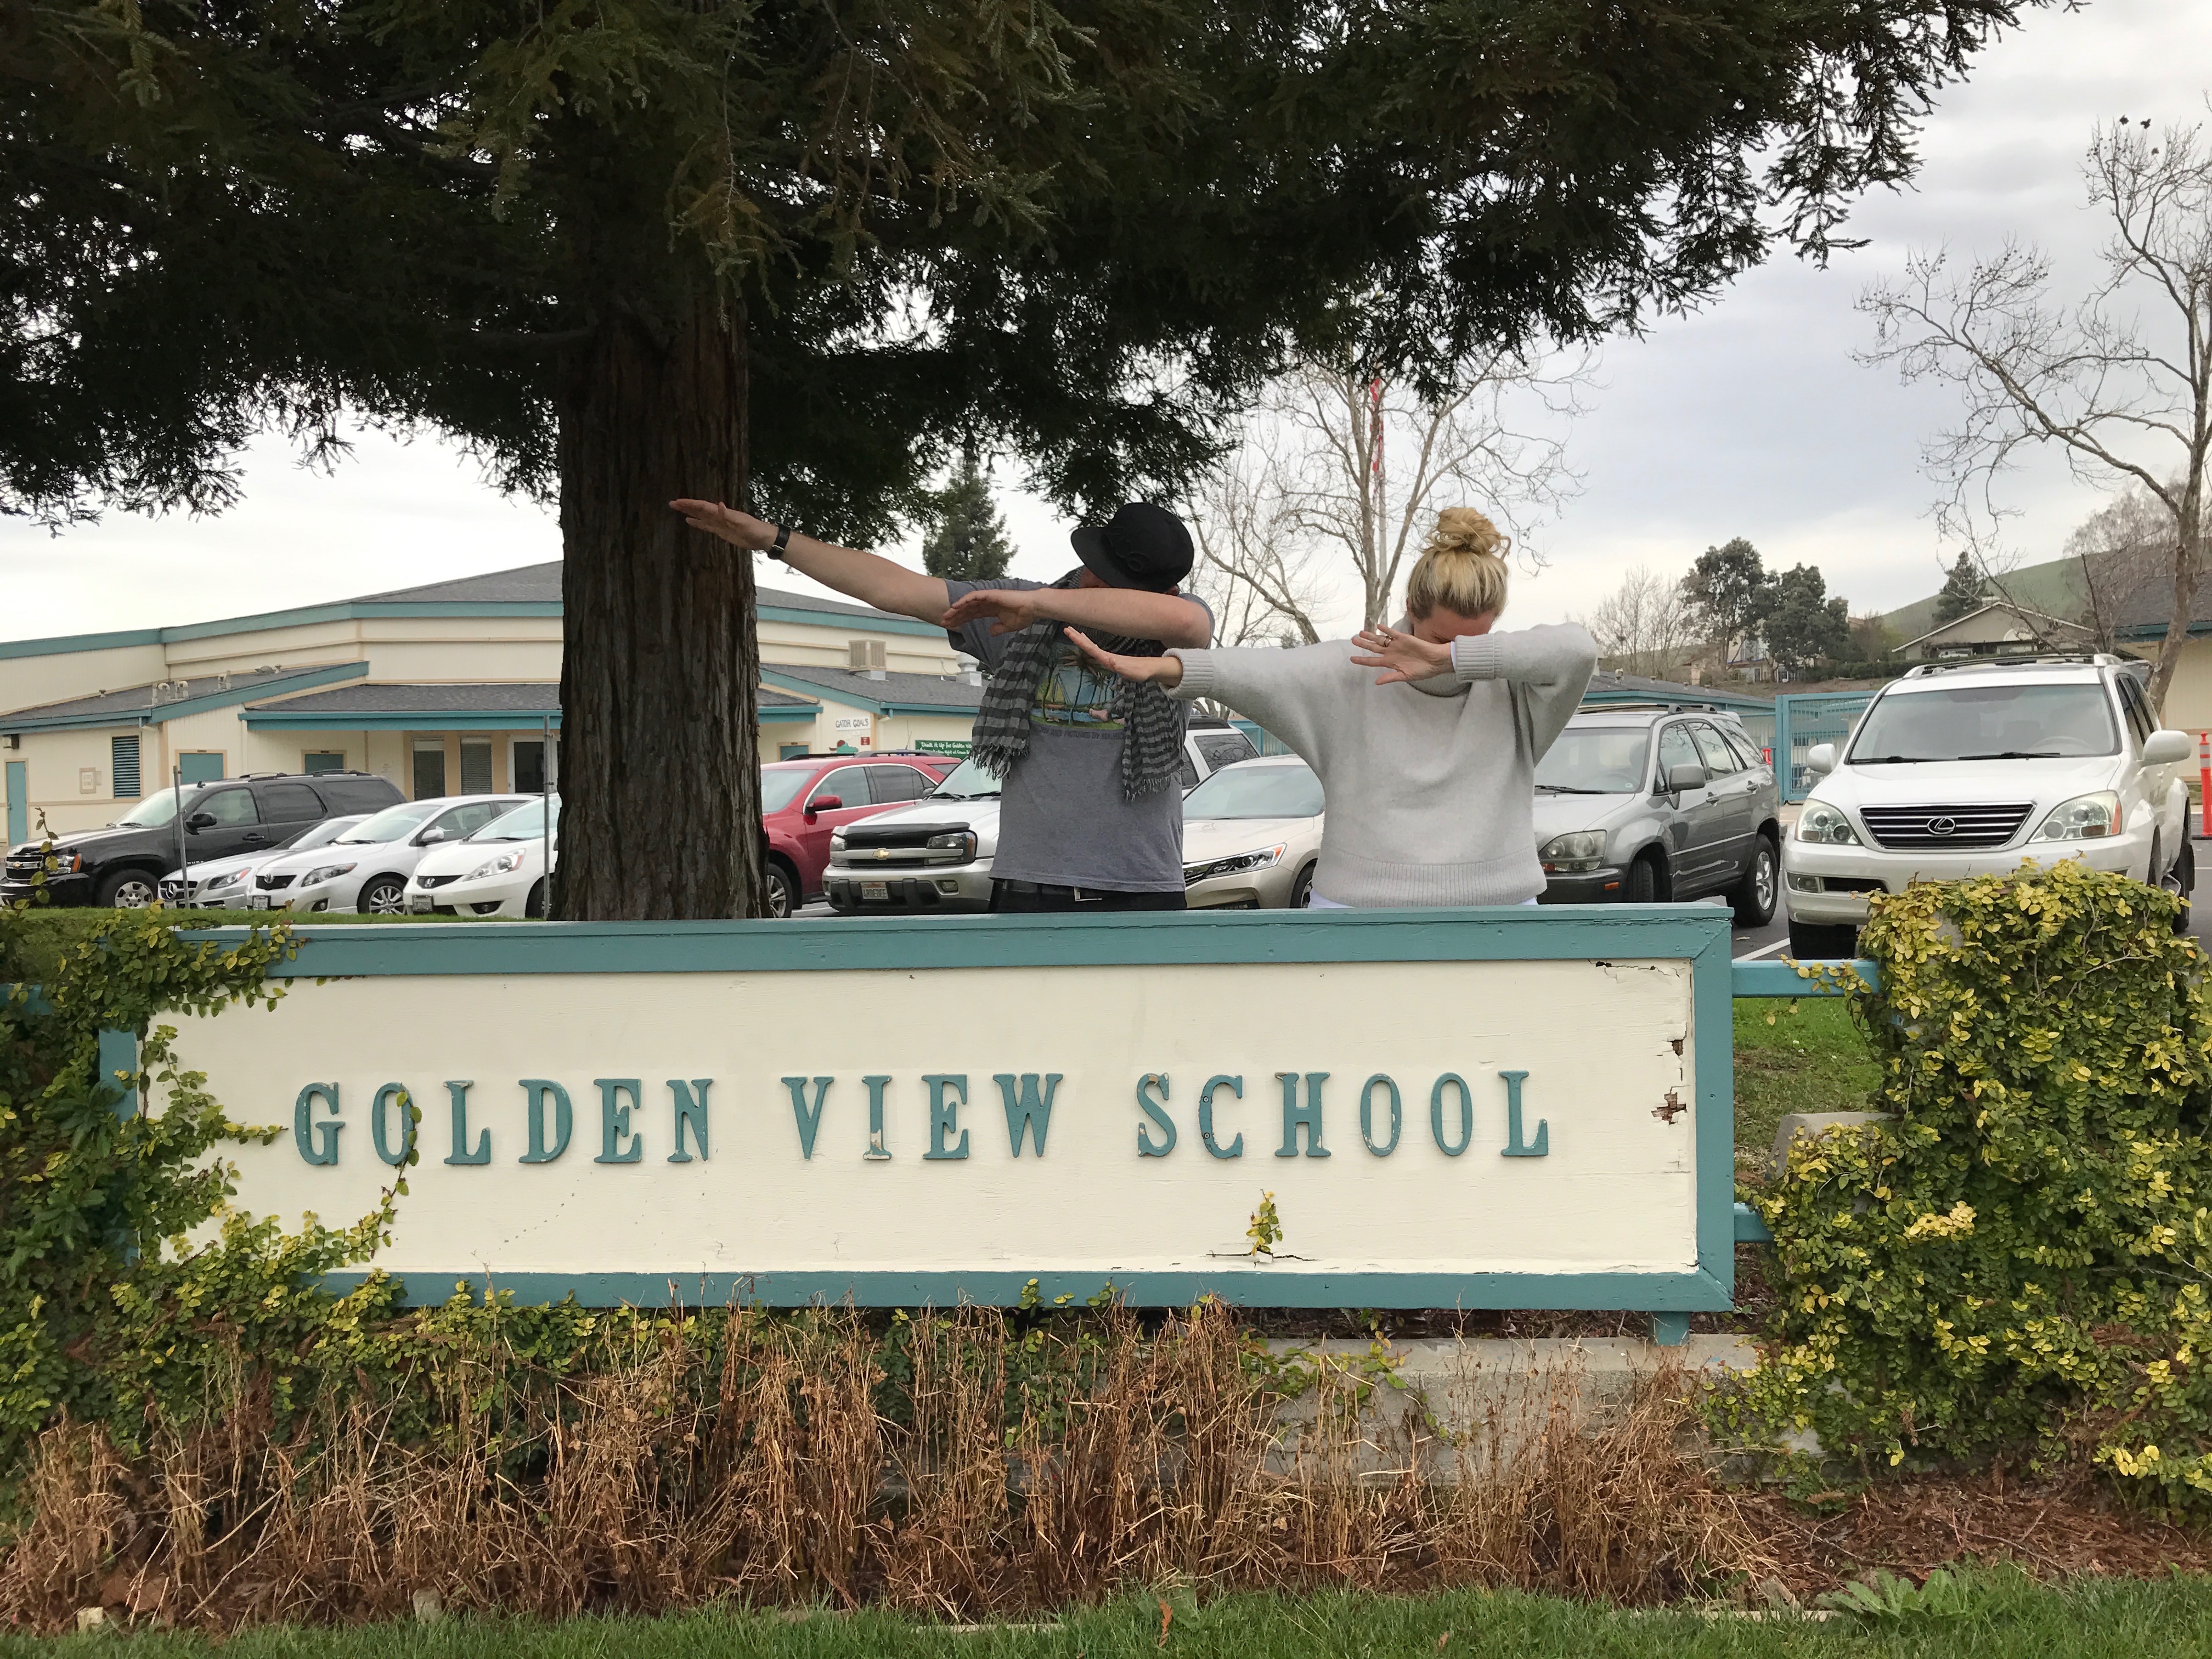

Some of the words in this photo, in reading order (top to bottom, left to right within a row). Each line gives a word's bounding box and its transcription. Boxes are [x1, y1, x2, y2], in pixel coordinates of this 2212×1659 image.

[836, 719, 851, 728] GATOR
[853, 718, 868, 727] GOALS
[1064, 730, 1090, 739] PICTURES
[294, 1078, 714, 1166] GOLDEN
[781, 1073, 1064, 1161] VIEW
[1136, 1070, 1549, 1159] SCHOOL
